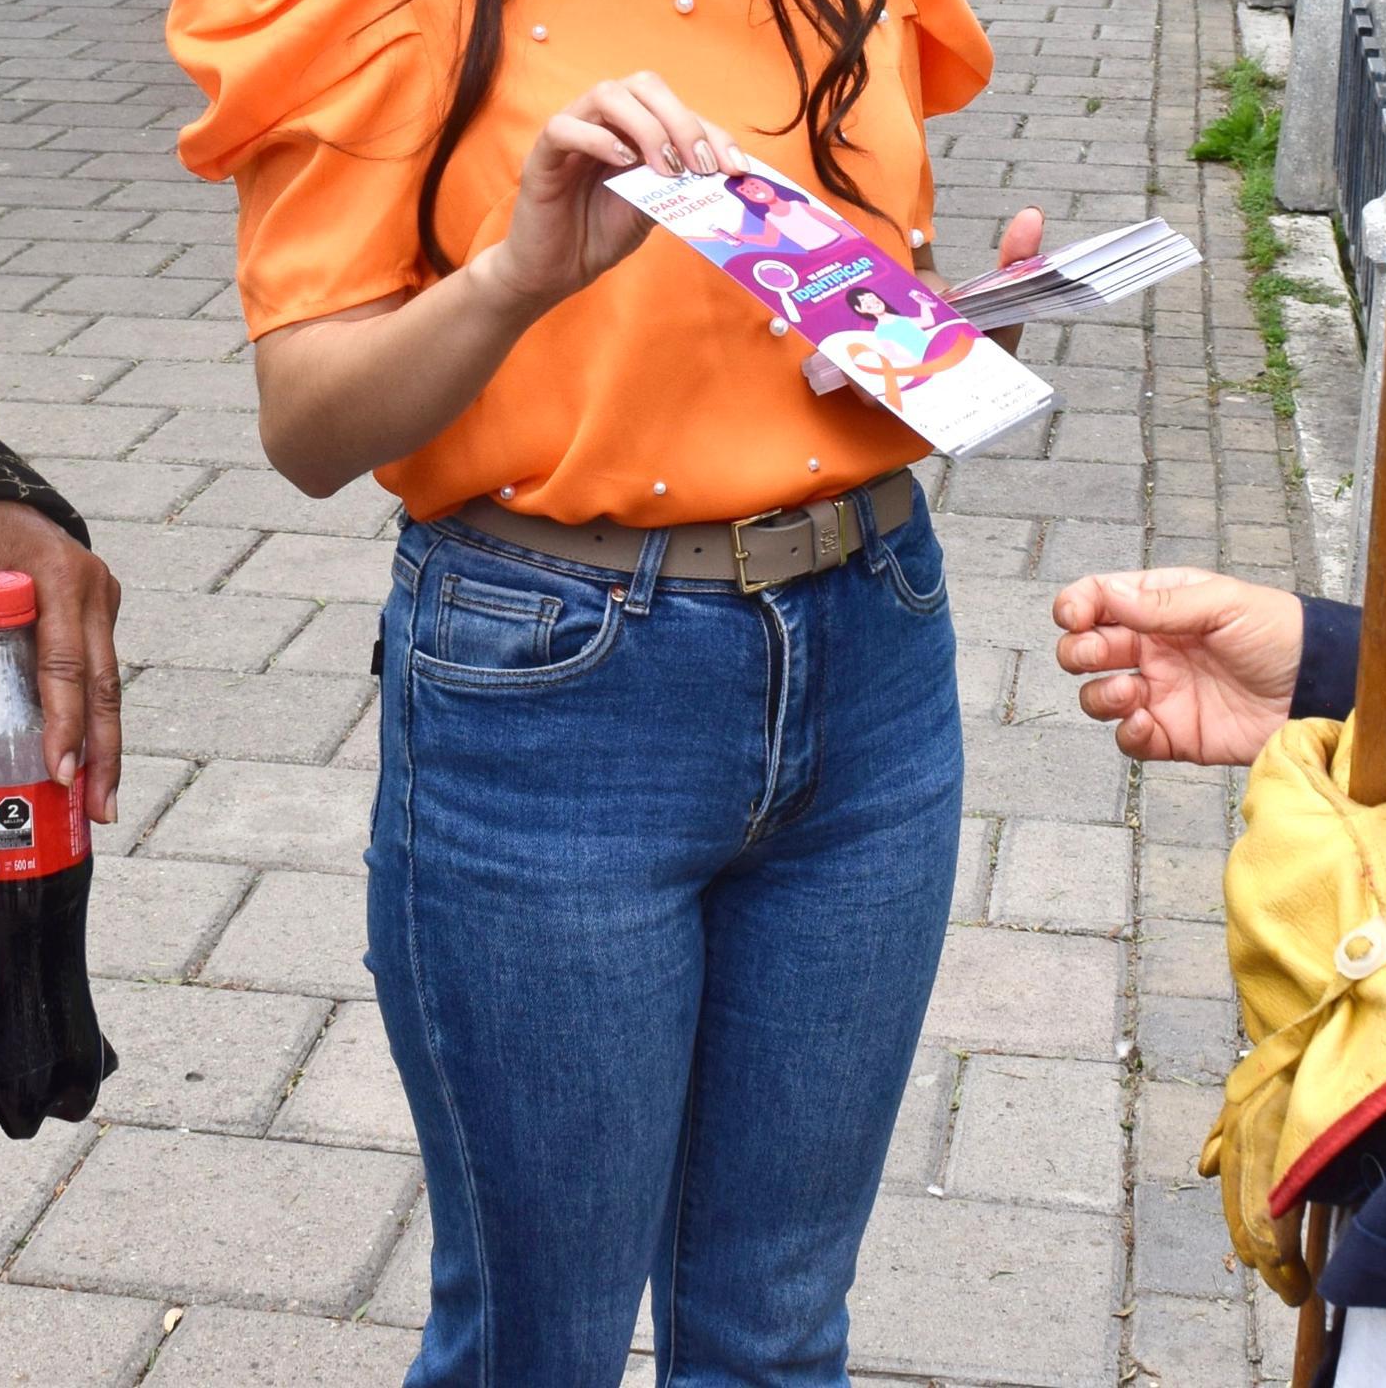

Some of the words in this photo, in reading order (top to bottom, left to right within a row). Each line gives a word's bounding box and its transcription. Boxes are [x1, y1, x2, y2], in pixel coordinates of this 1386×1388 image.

[649, 194, 690, 214] PARA
[662, 191, 725, 224] MUJERES
[792, 256, 875, 303] IDENTIFICAR
[7, 804, 20, 819] 2
[14, 859, 28, 871] 600
[27, 857, 36, 869] ml
